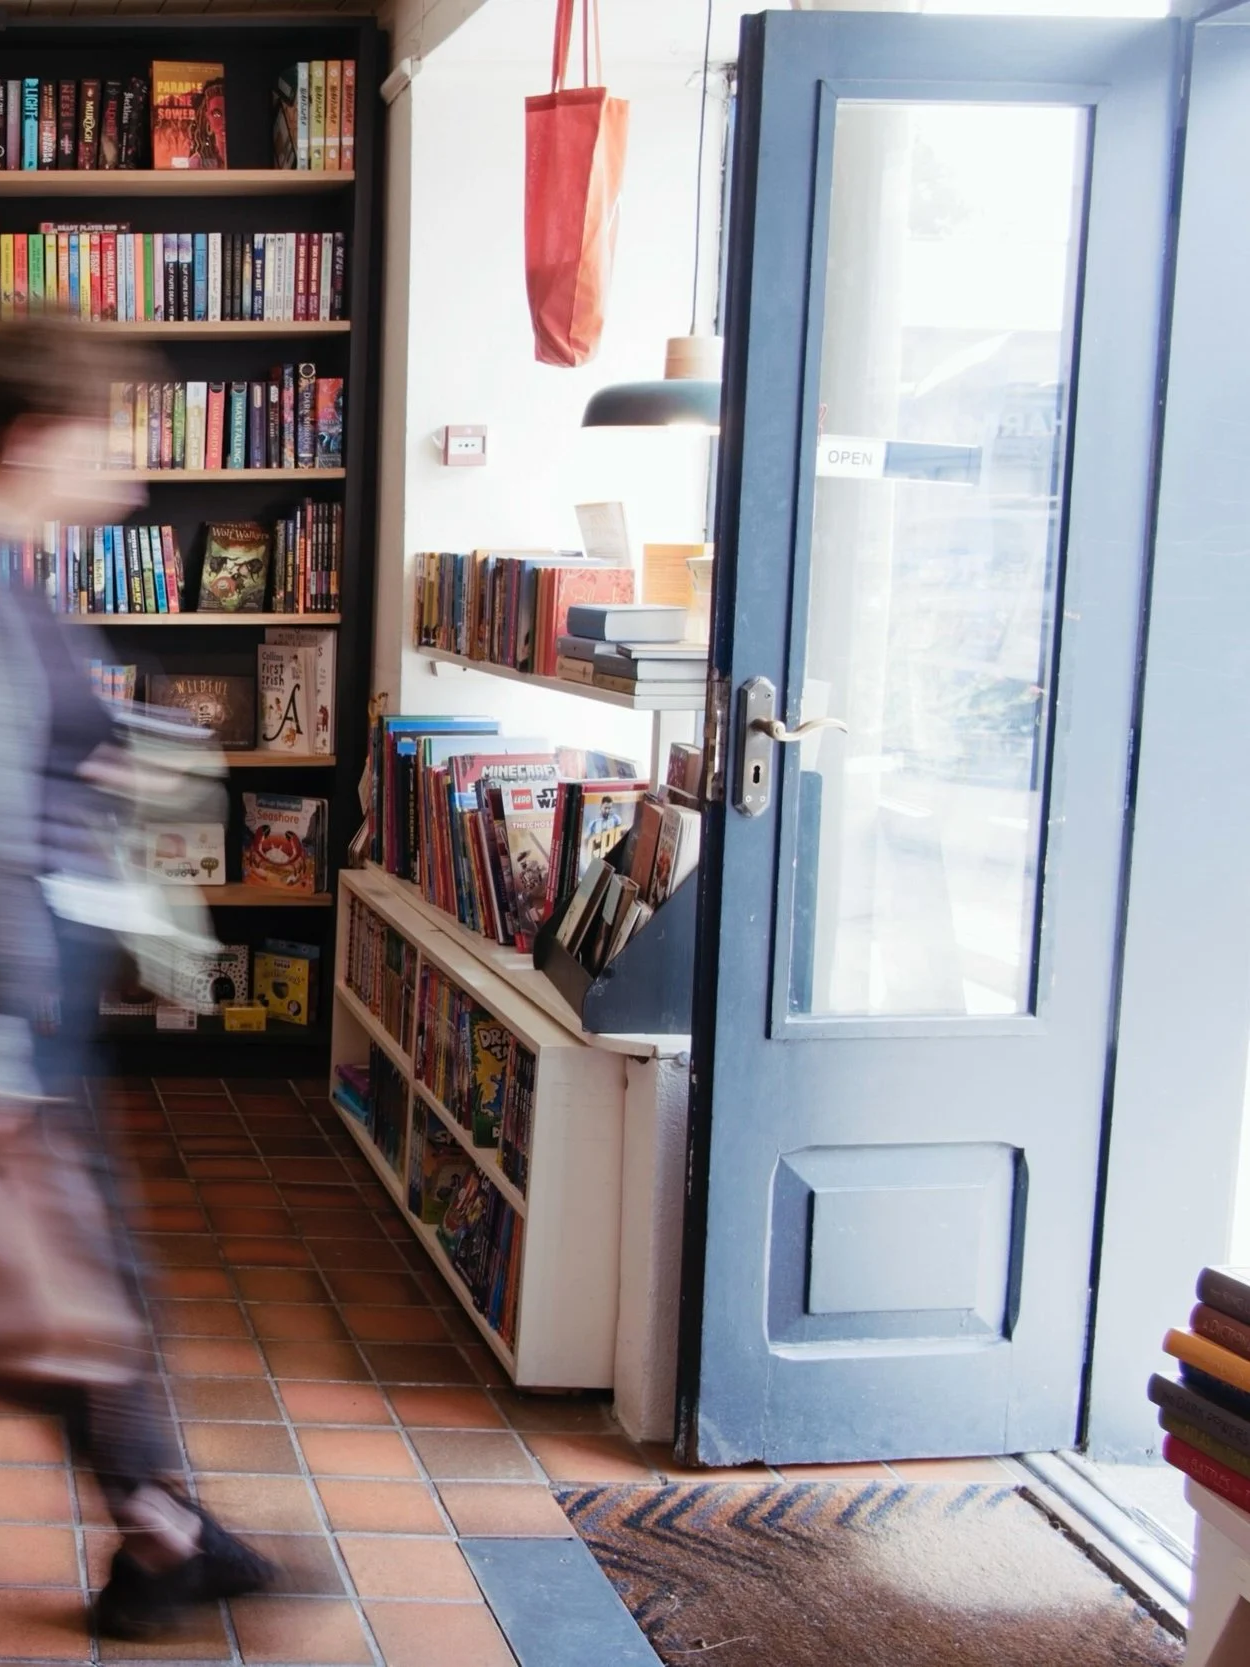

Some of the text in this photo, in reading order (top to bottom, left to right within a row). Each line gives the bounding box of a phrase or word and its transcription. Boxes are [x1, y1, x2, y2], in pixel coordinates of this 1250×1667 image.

[157, 81, 203, 120] PARABLE THE SOWER
[83, 101, 95, 142] MURTAGH
[57, 224, 77, 232] READY
[79, 224, 103, 232] PLAYER
[303, 392, 312, 415] DARK
[234, 400, 244, 463] MASK FALLING
[827, 449, 873, 466] OPEN
[262, 651, 284, 661] Collins
[262, 663, 285, 675] First
[175, 679, 229, 695] WILDFUL
[262, 675, 285, 686] Irish
[262, 683, 304, 741] A
[481, 764, 560, 779] MINECRAFT
[513, 794, 531, 804] LEGO
[257, 809, 300, 824] Seashore
[1177, 1395, 1203, 1421] DARK
[1190, 1458, 1232, 1494] BATTLES
